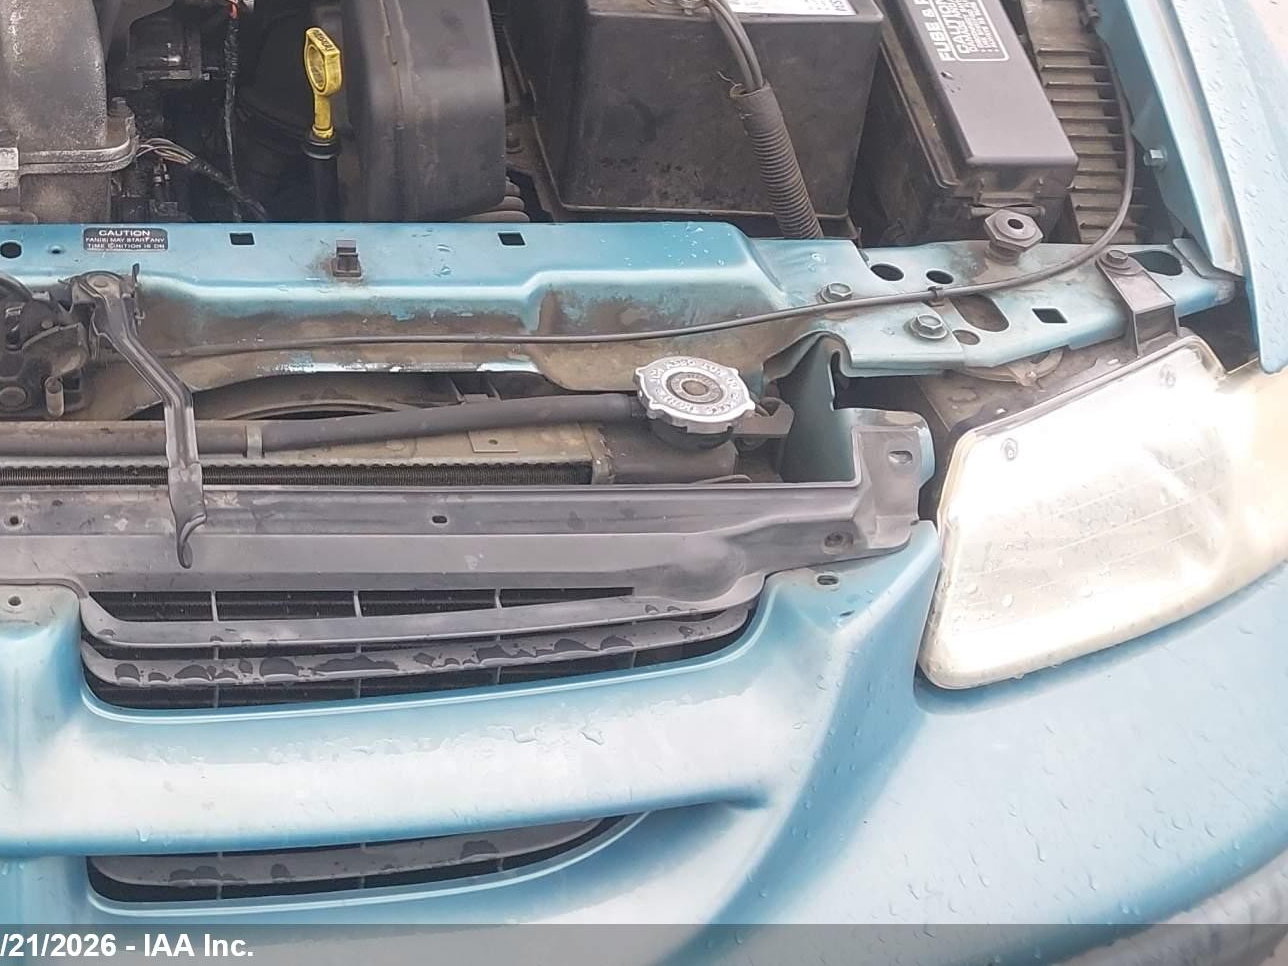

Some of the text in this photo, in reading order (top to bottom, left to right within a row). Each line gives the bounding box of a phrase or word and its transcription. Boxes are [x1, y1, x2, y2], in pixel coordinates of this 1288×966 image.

[920, 8, 935, 17] &
[924, 21, 956, 61] FUSE
[98, 229, 151, 237] CAUTION
